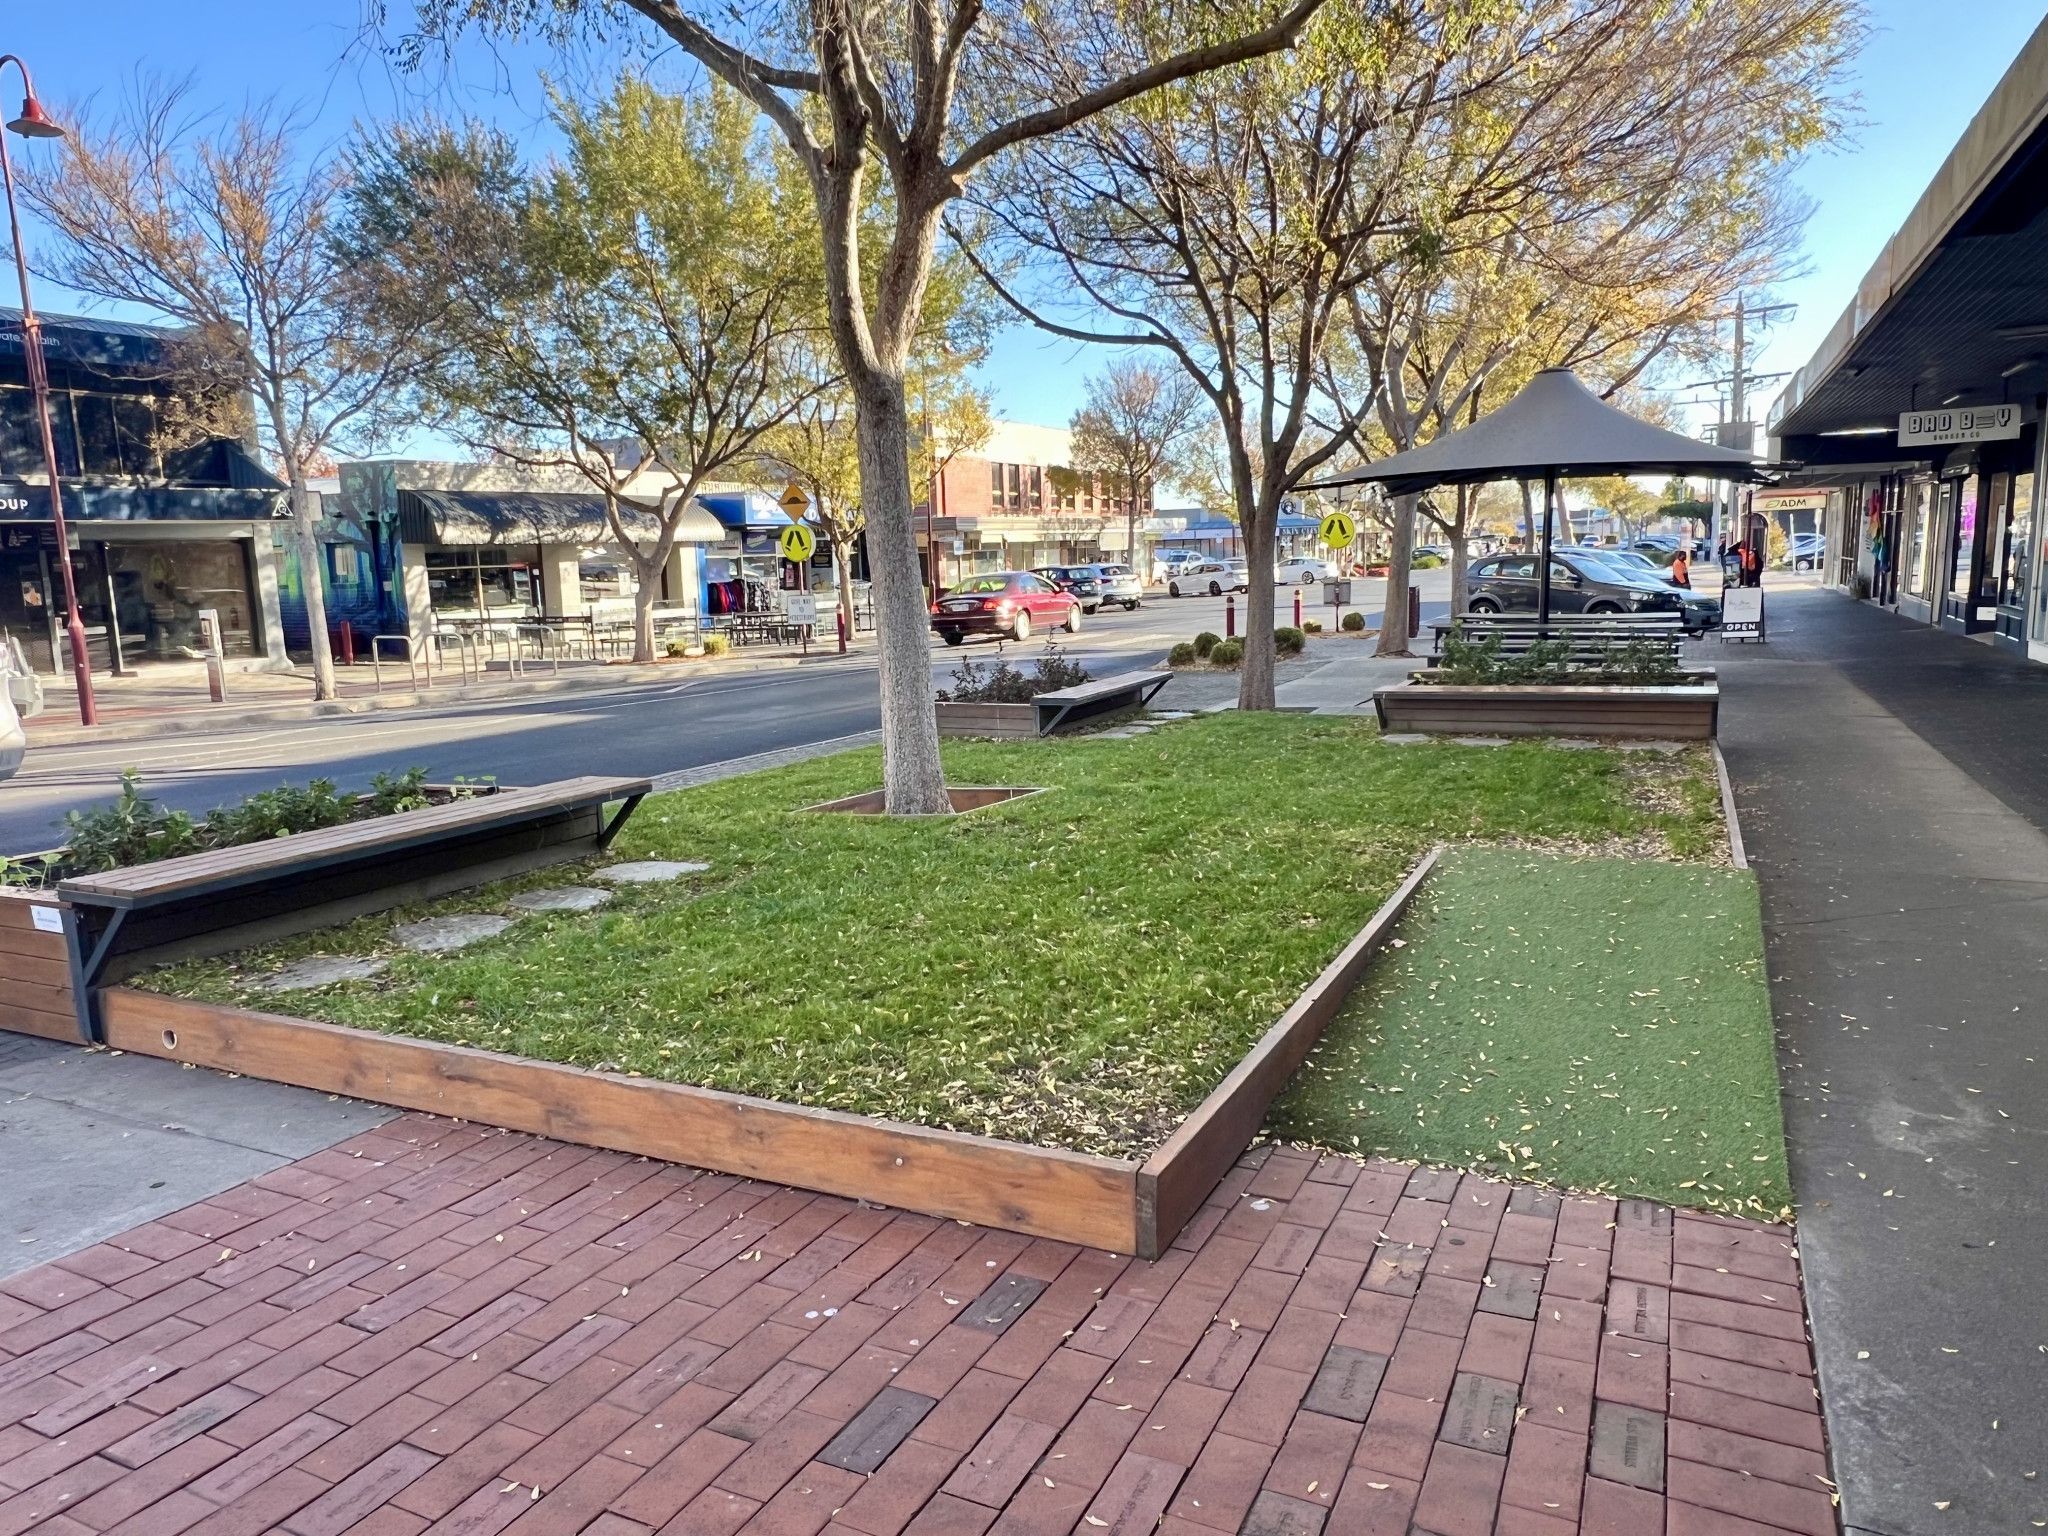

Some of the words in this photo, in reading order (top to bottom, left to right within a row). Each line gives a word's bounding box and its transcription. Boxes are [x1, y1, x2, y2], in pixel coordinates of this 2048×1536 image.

[1909, 414, 1951, 434] BAD
[1780, 499, 1807, 508] ADM
[1726, 623, 1756, 631] OPEN
